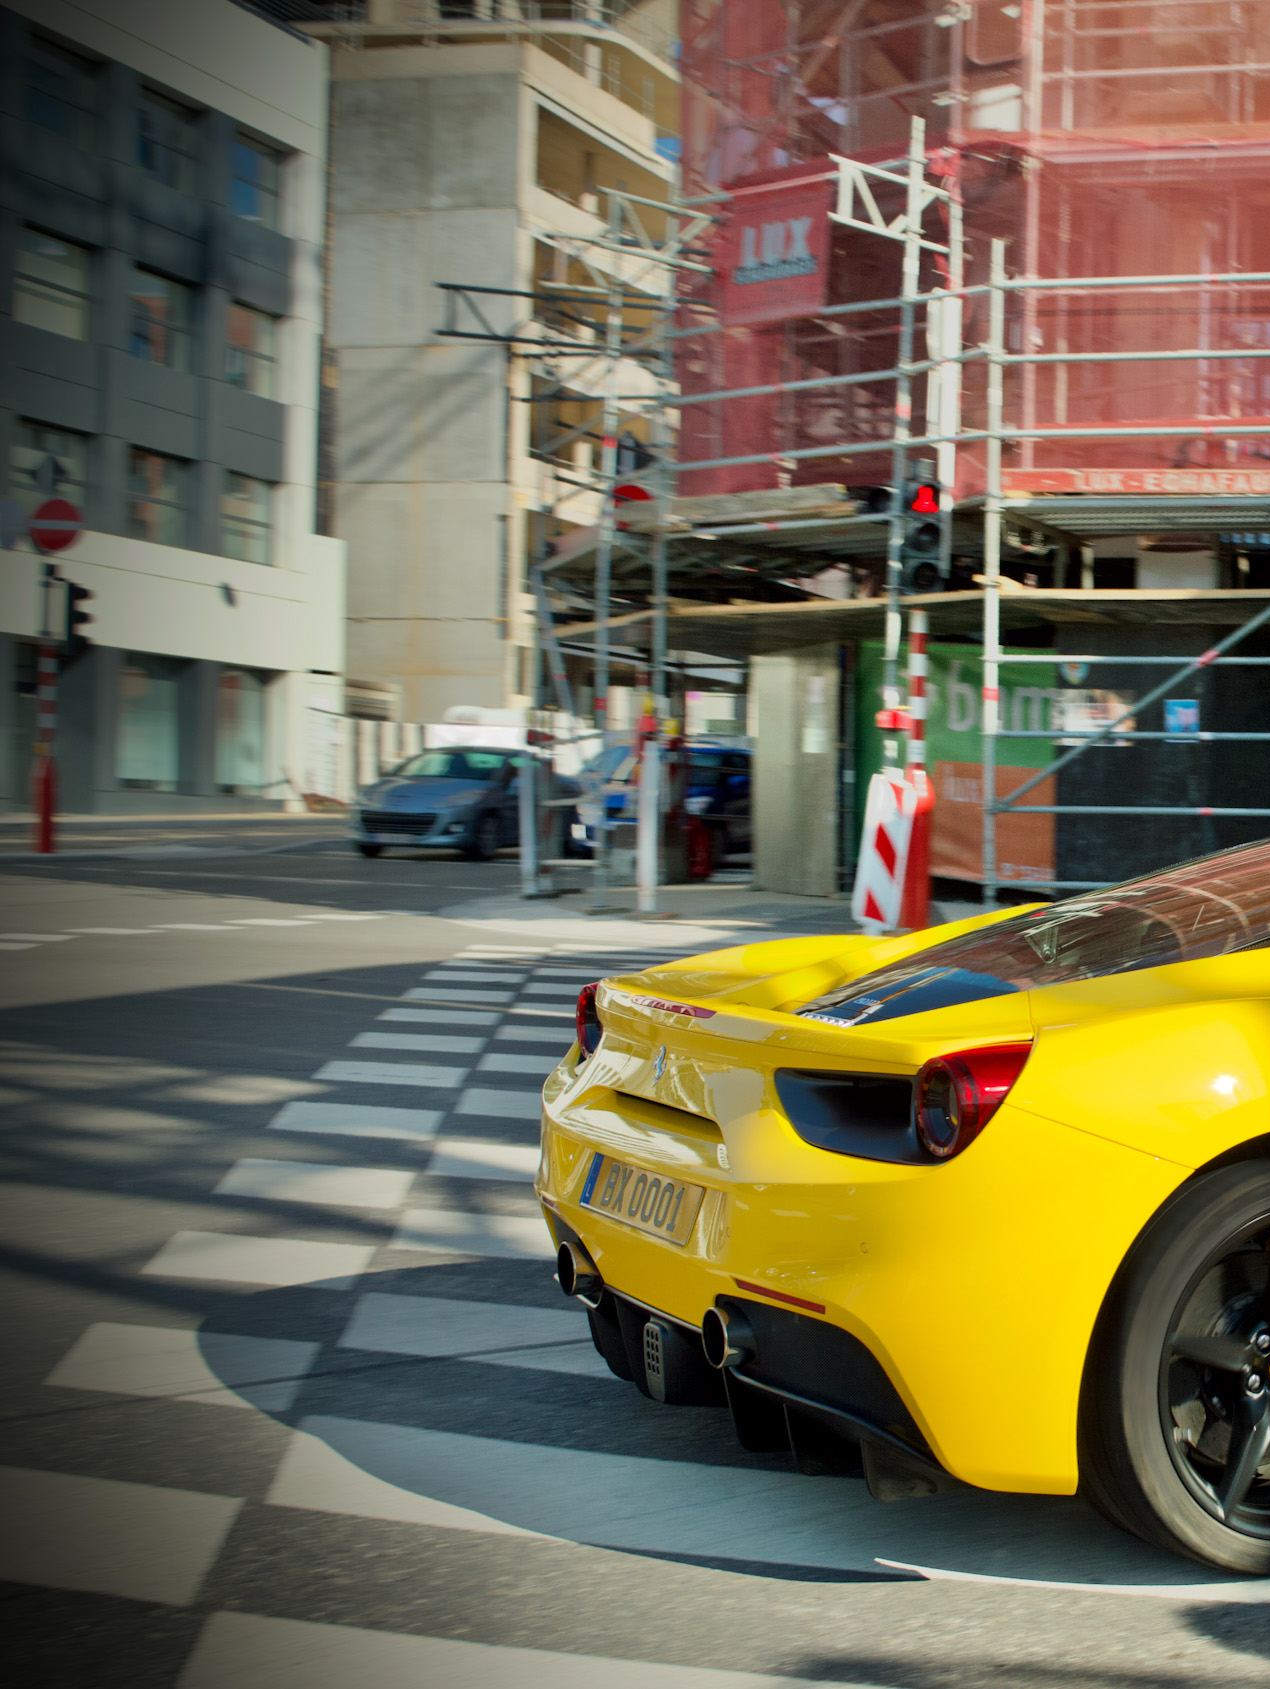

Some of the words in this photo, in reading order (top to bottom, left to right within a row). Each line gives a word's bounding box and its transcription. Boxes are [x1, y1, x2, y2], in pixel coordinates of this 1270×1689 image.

[742, 216, 813, 268] LUX
[1074, 473, 1125, 490] LUX
[947, 660, 1058, 732] bm
[600, 1163, 634, 1212] BX
[628, 1173, 686, 1233] 0001
